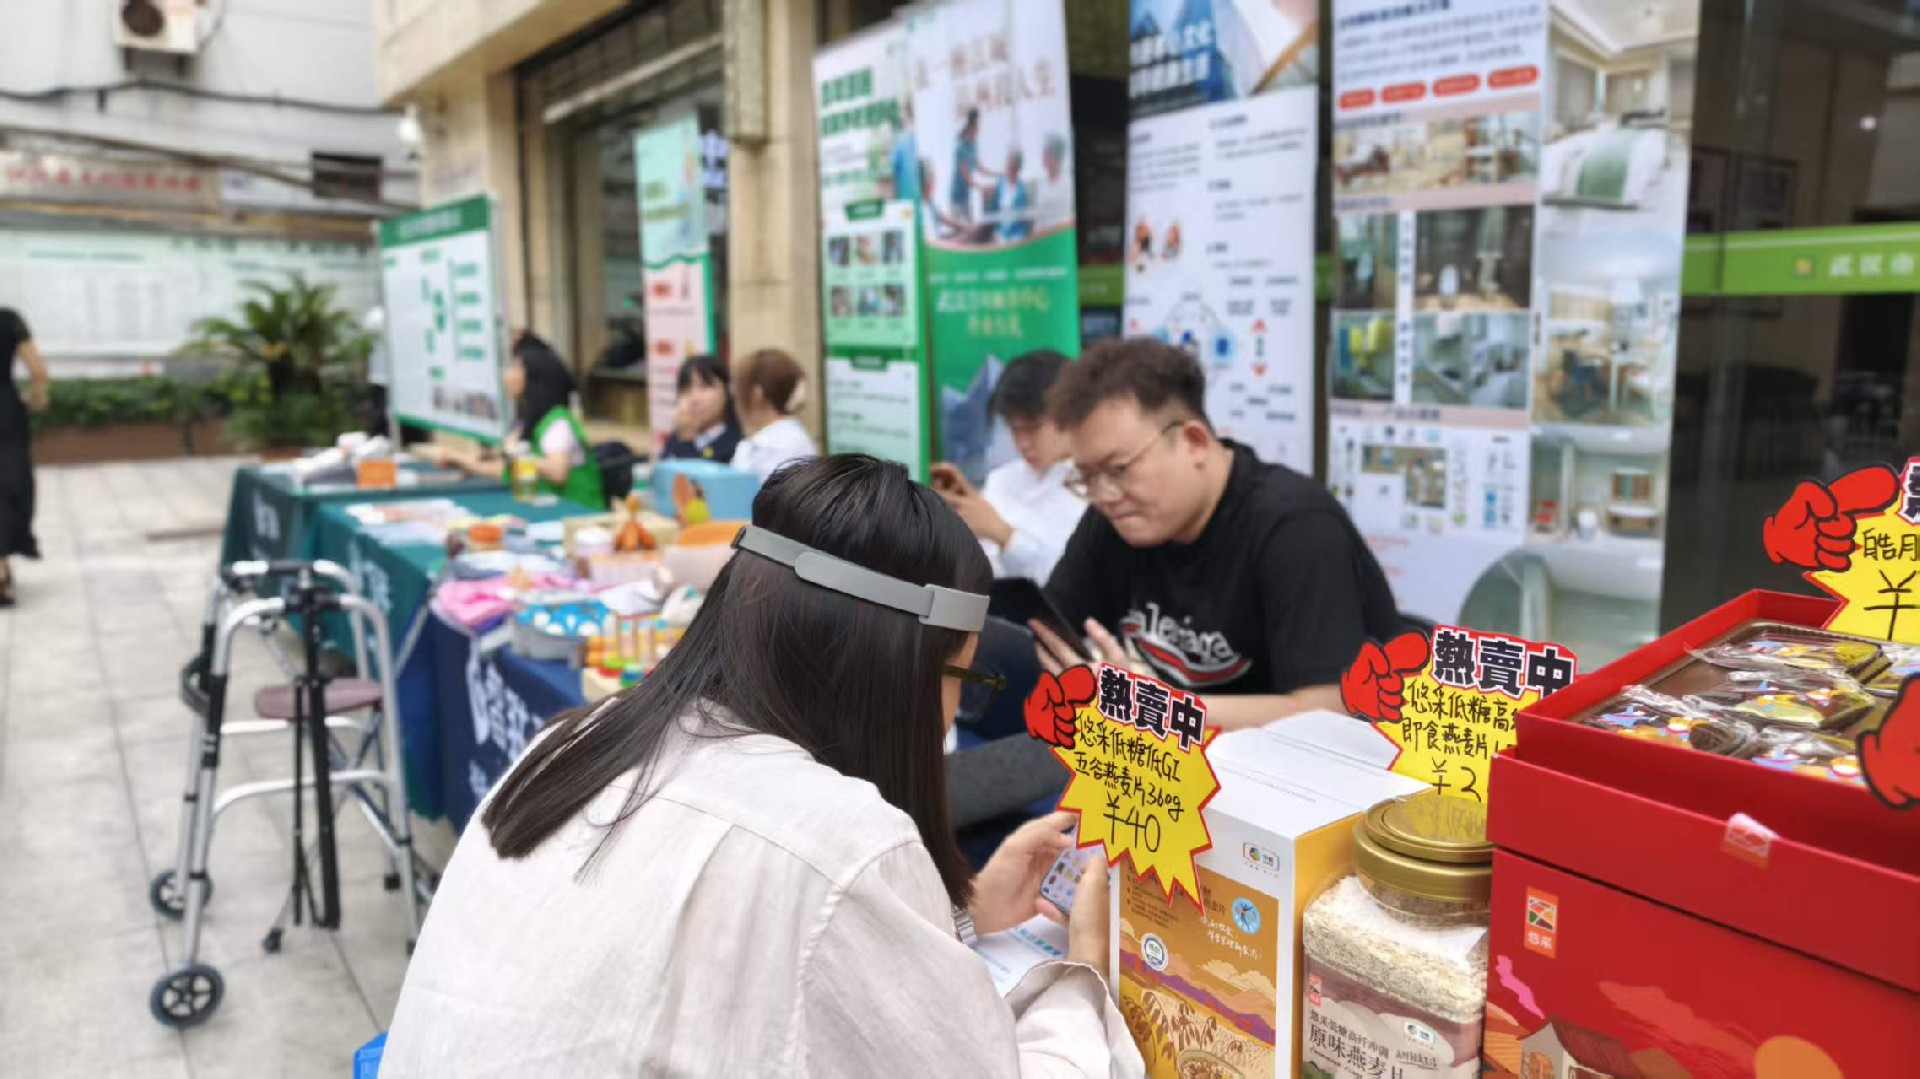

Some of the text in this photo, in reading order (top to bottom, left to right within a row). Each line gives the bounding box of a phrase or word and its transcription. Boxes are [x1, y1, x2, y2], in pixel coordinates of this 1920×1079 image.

[1433, 629, 1574, 698] 熱賣中
[1099, 667, 1205, 751] 熱賣中
[1103, 791, 1161, 853] ¥40
